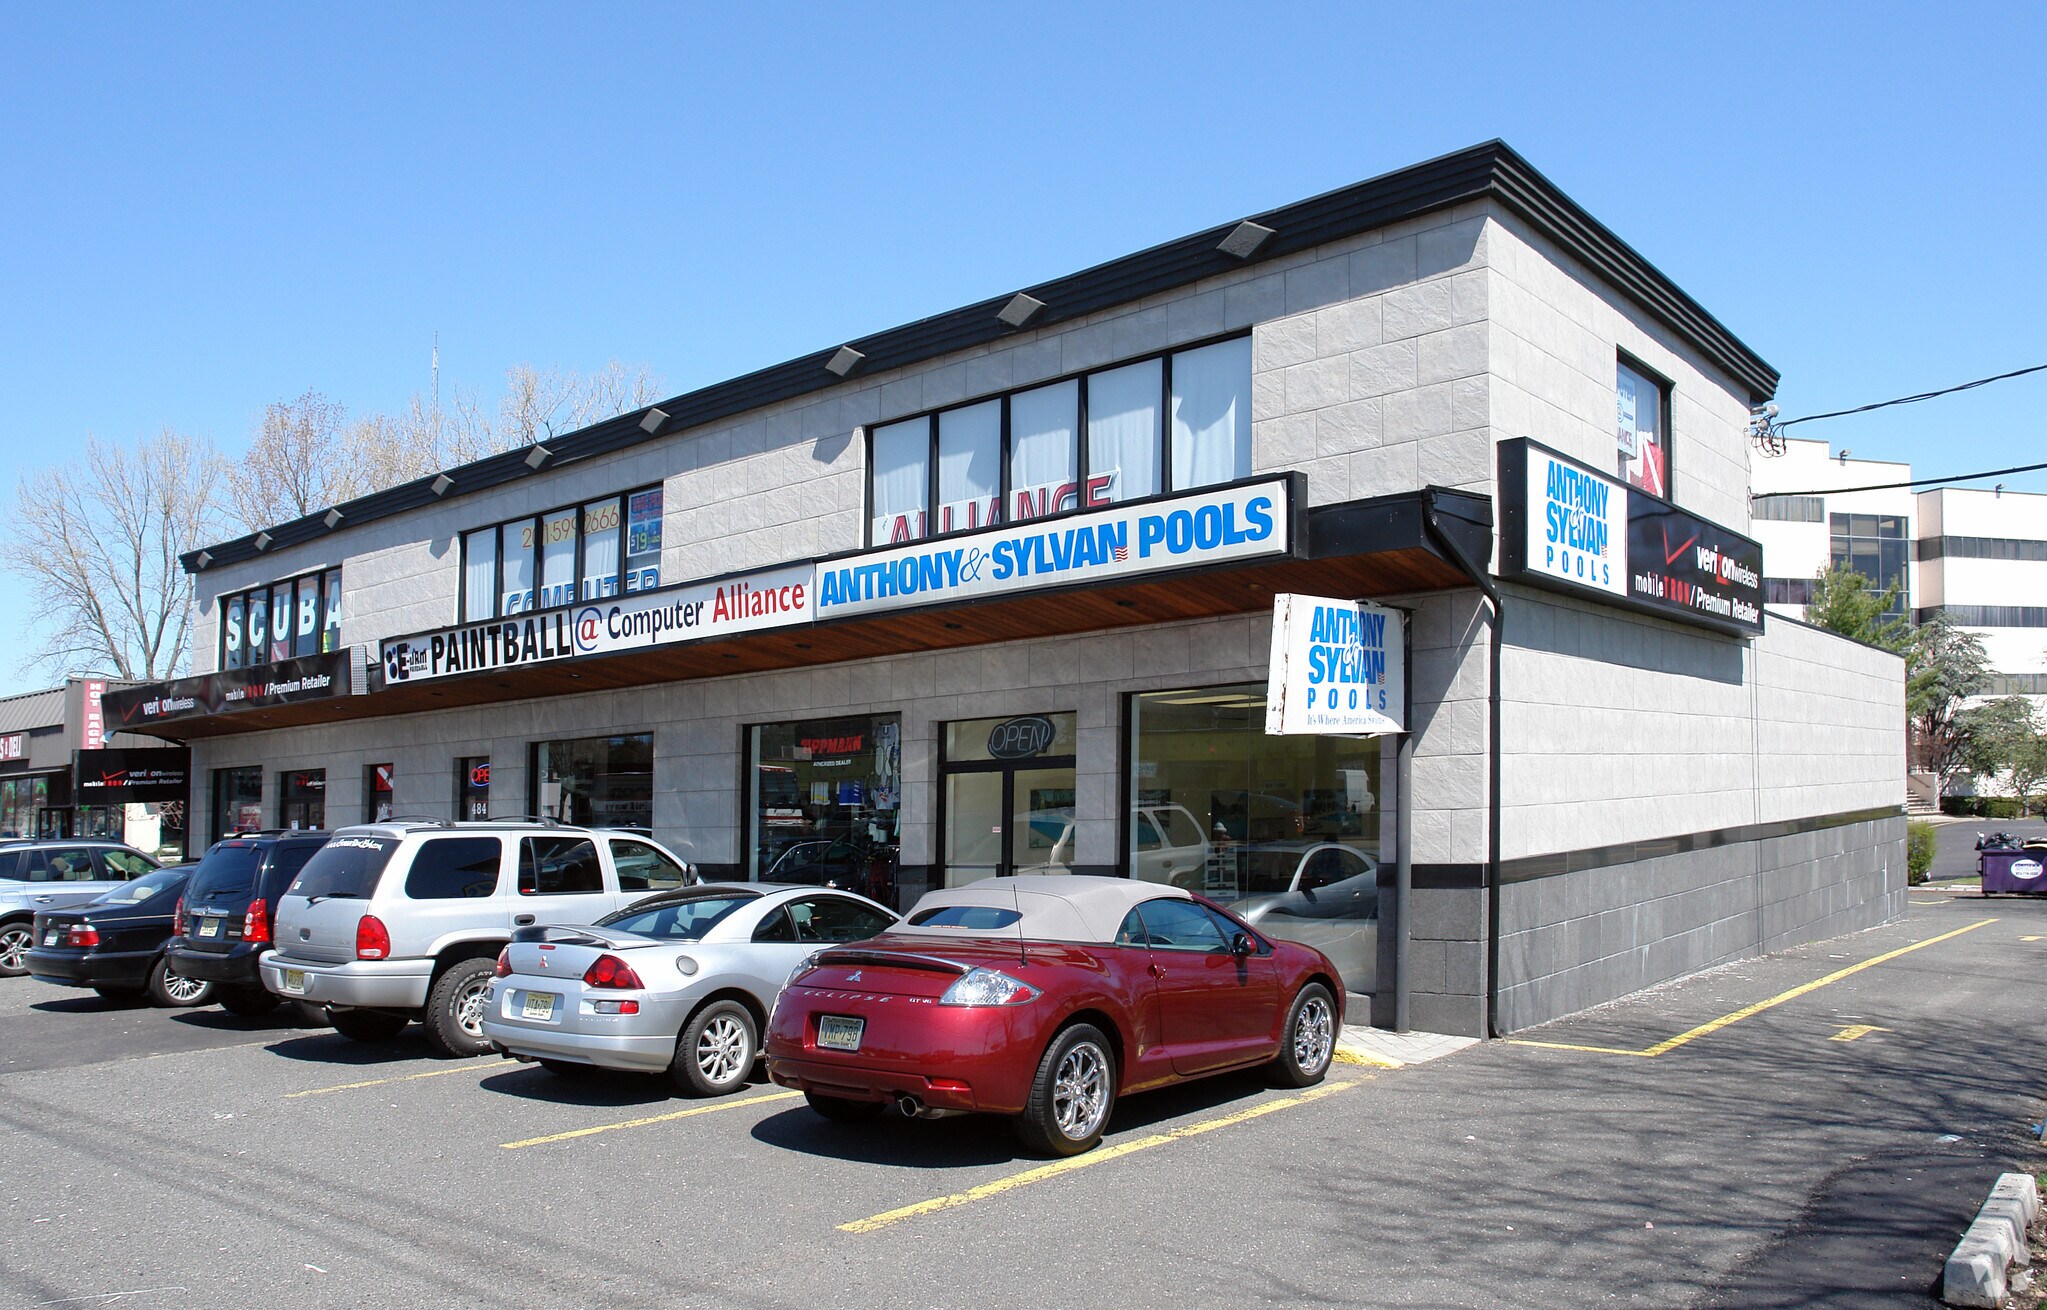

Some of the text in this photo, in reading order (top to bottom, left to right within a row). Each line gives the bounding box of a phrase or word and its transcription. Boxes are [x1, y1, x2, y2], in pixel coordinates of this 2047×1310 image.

[1546, 460, 1609, 520] ANTHONY
[1546, 501, 1608, 556] SYLVAN
[1570, 496, 1585, 531] &
[820, 496, 1274, 607] ANTHONY & SYLVAN POOLS
[1546, 546, 1609, 586] POOLS
[226, 581, 342, 651] SCUBA
[607, 598, 704, 643] Computer
[712, 582, 805, 624] Alliance
[1696, 587, 1732, 617] Premium
[1733, 597, 1760, 624] Retailer
[431, 612, 571, 676] PAINTBALL
[1310, 606, 1386, 649] ANTHONY
[1308, 645, 1385, 685] SYLVAN
[89, 683, 102, 706] HOT
[269, 680, 300, 696] Premium
[301, 674, 331, 690] Retailer
[1307, 687, 1386, 710] POOLS
[88, 713, 101, 749] BAGE
[991, 724, 1048, 752] OPEN
[471, 768, 490, 782] OPE
[472, 803, 487, 815] 484
[804, 990, 893, 1003] ECLIPSE
